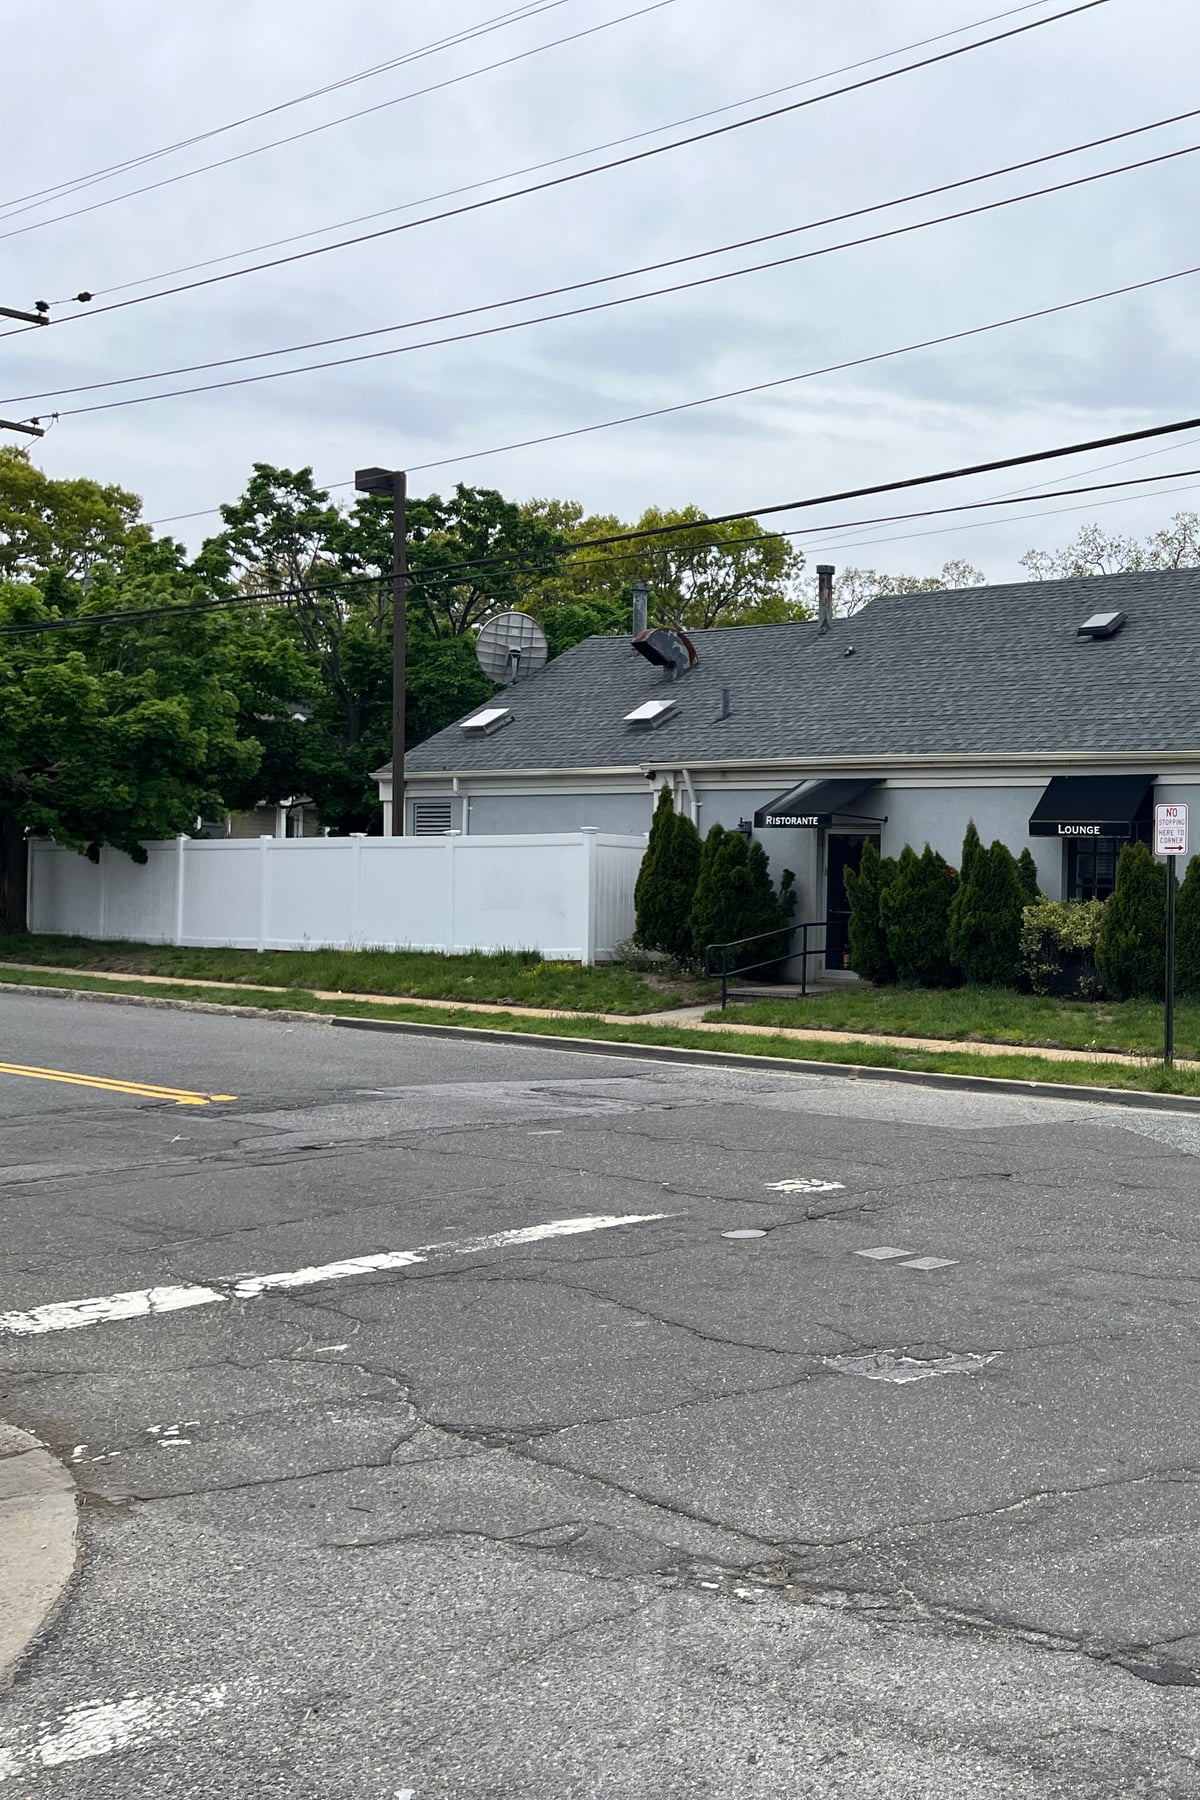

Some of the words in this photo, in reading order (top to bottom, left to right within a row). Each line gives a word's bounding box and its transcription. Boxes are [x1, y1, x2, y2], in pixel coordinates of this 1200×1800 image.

[1166, 808, 1178, 817] NO
[765, 815, 819, 825] RISTORANTE
[1057, 824, 1100, 835] LOUNGE
